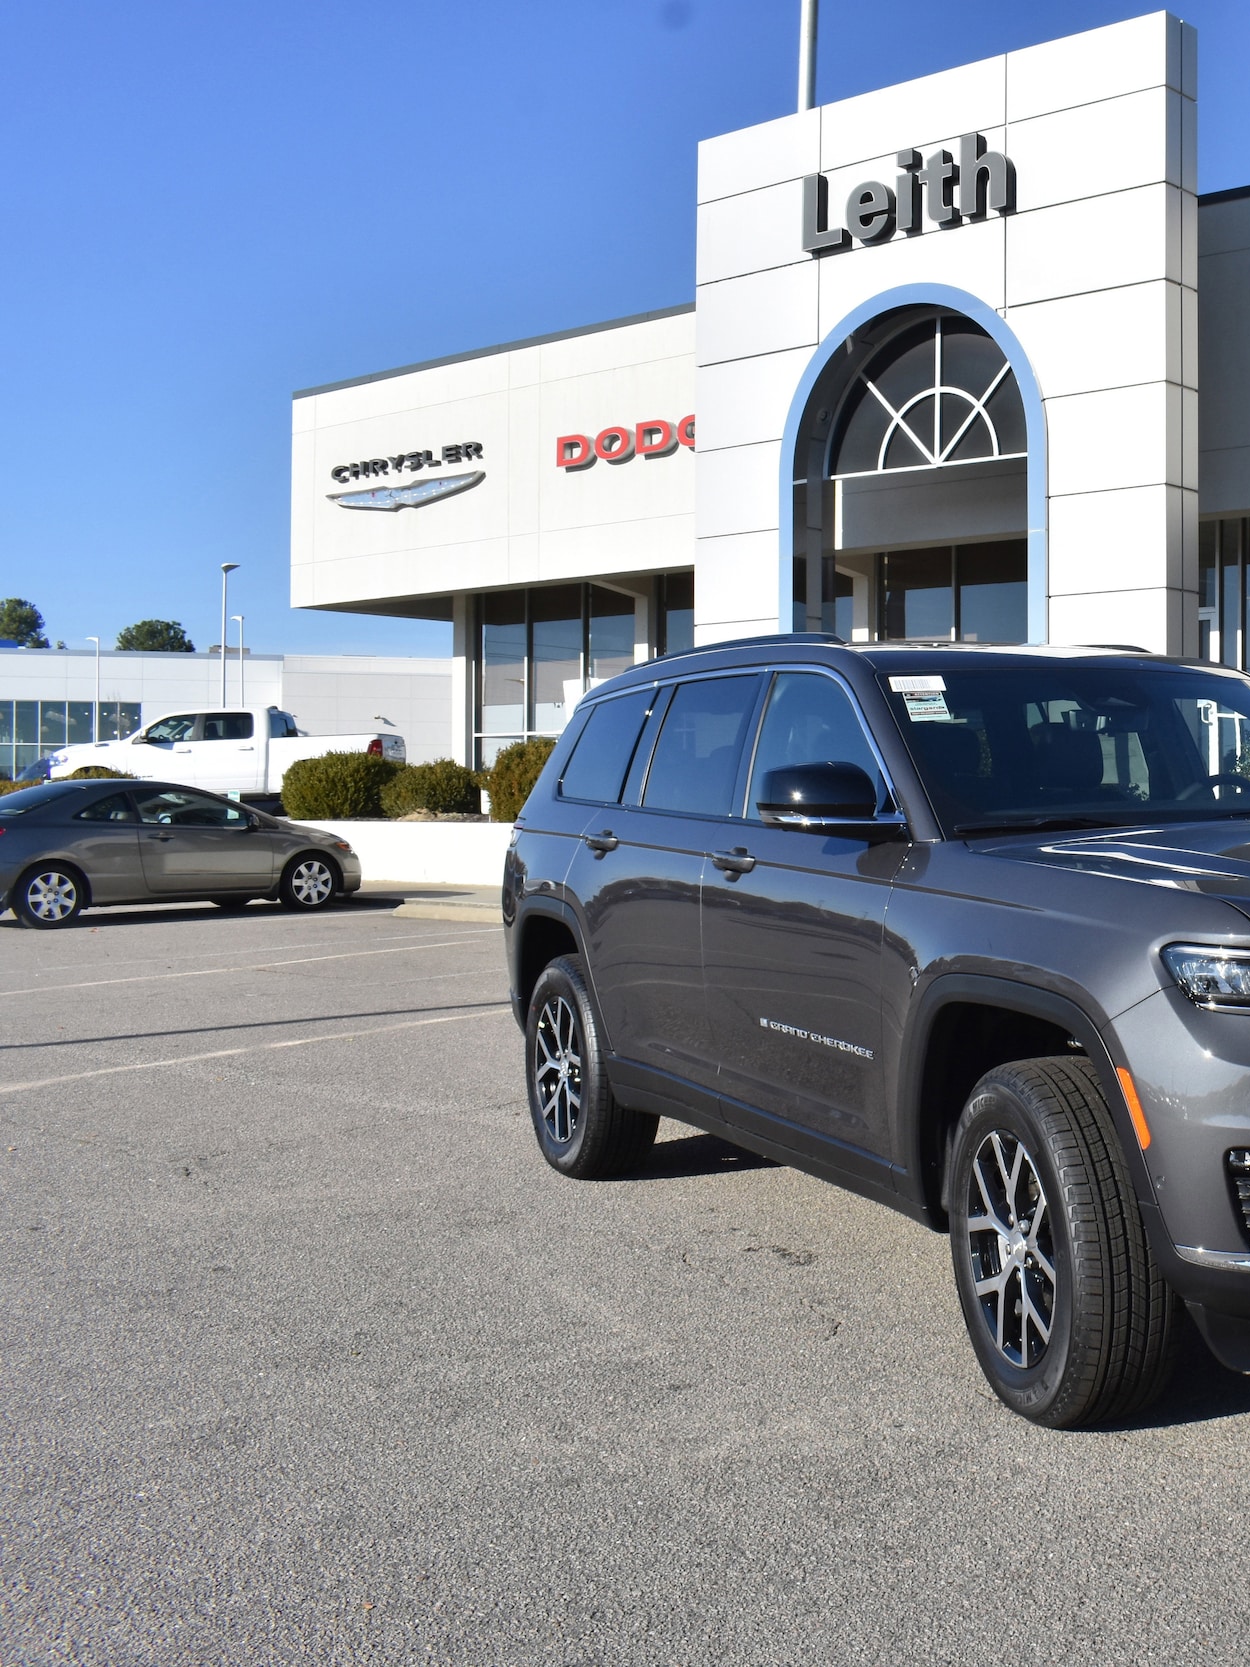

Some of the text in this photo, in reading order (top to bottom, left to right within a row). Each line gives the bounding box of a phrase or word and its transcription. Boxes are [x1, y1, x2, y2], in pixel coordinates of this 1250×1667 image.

[802, 132, 1014, 257] Leith
[330, 441, 484, 484] CHRYSLER
[769, 1020, 875, 1061] GRAND CHEROKEE
